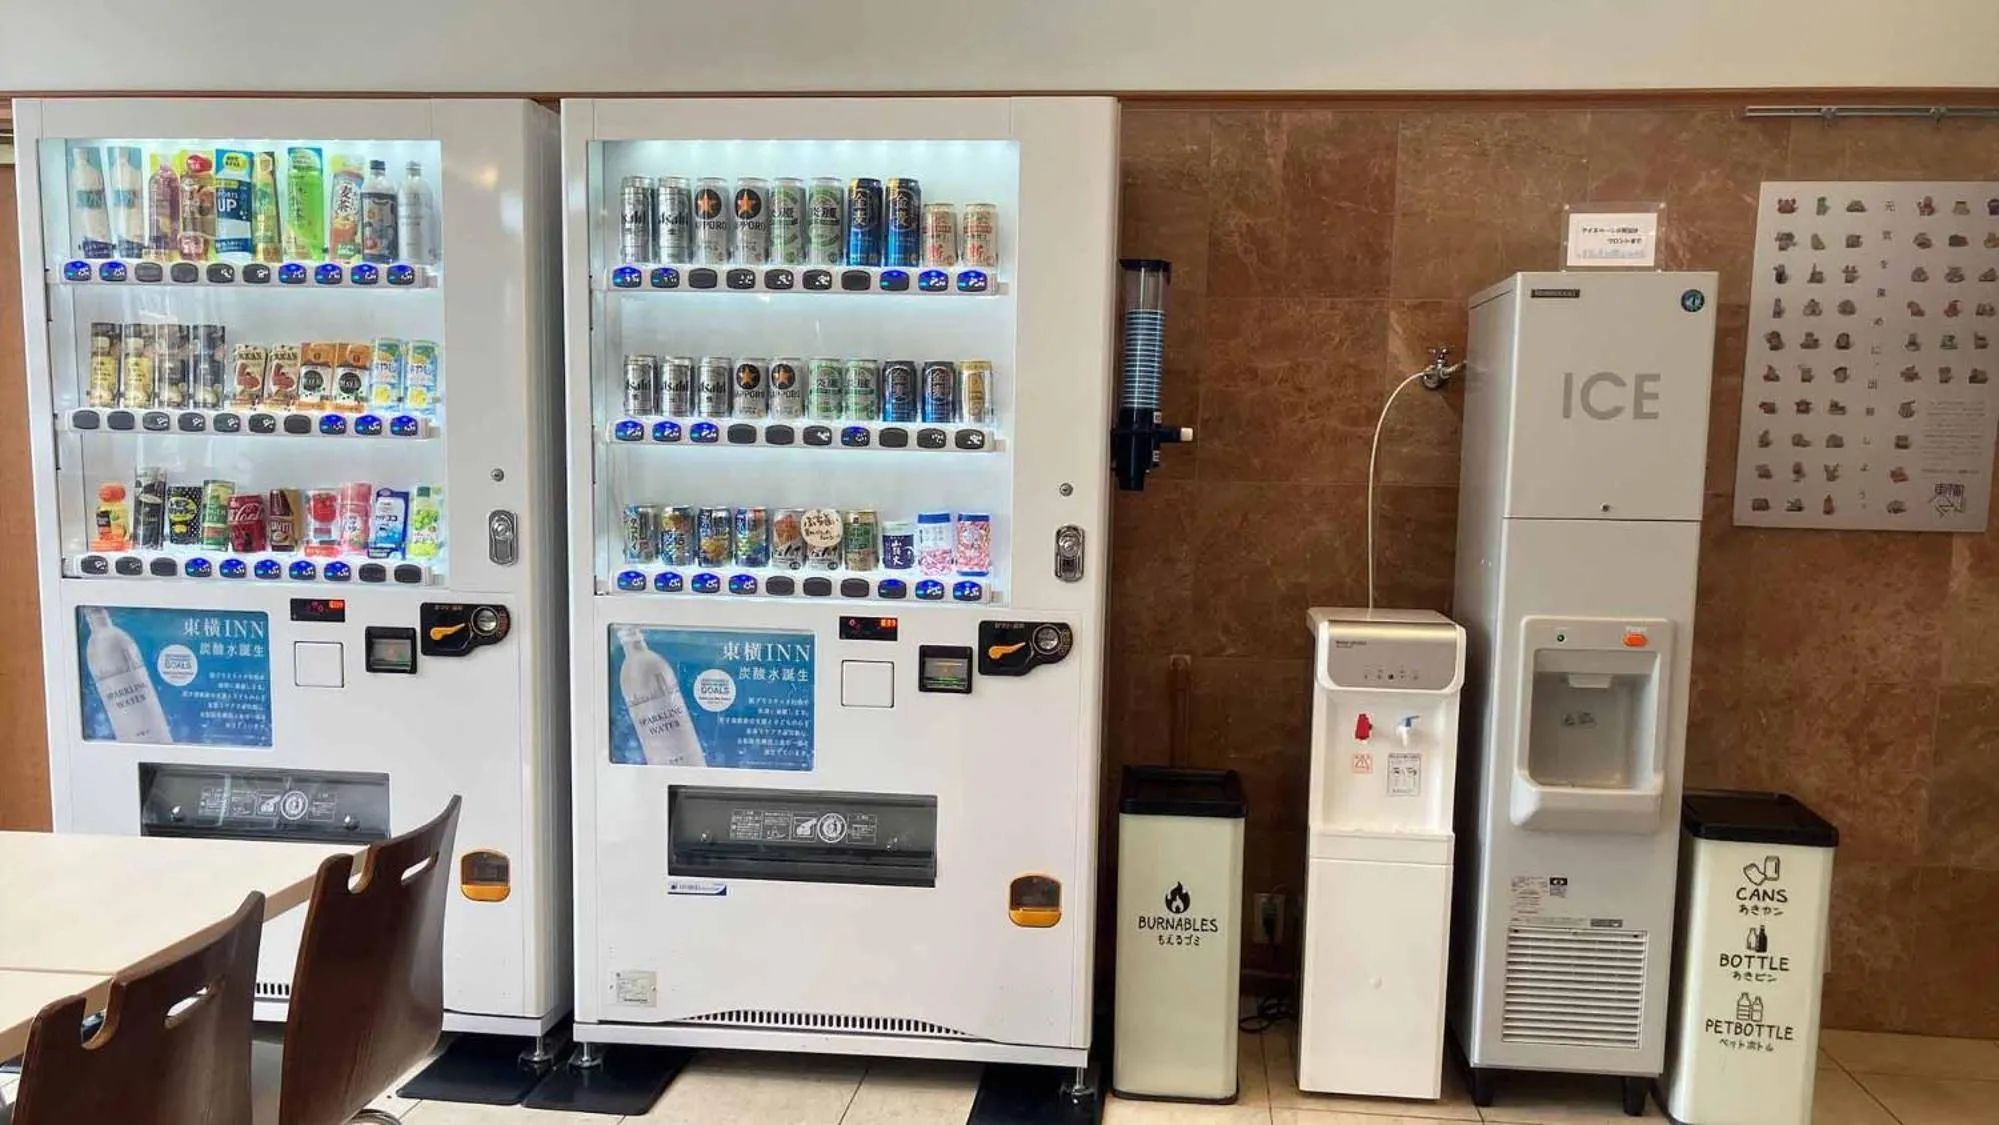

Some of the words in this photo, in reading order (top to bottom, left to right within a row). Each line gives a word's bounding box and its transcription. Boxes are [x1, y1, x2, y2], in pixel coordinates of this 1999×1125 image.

[217, 199, 237, 212] UP
[1562, 371, 1661, 421] ICE
[184, 617, 265, 639] 東横INN
[723, 641, 810, 662] 東横INN
[738, 667, 809, 682] 炭酸水誕生
[1735, 887, 1789, 904] CANS
[1738, 903, 1784, 917] あきカン
[1138, 915, 1219, 933] BURNABLES
[1158, 934, 1201, 947] もえるゴミ
[1720, 954, 1790, 971] BOTTLE
[1705, 1019, 1793, 1040] PETBOTTLE
